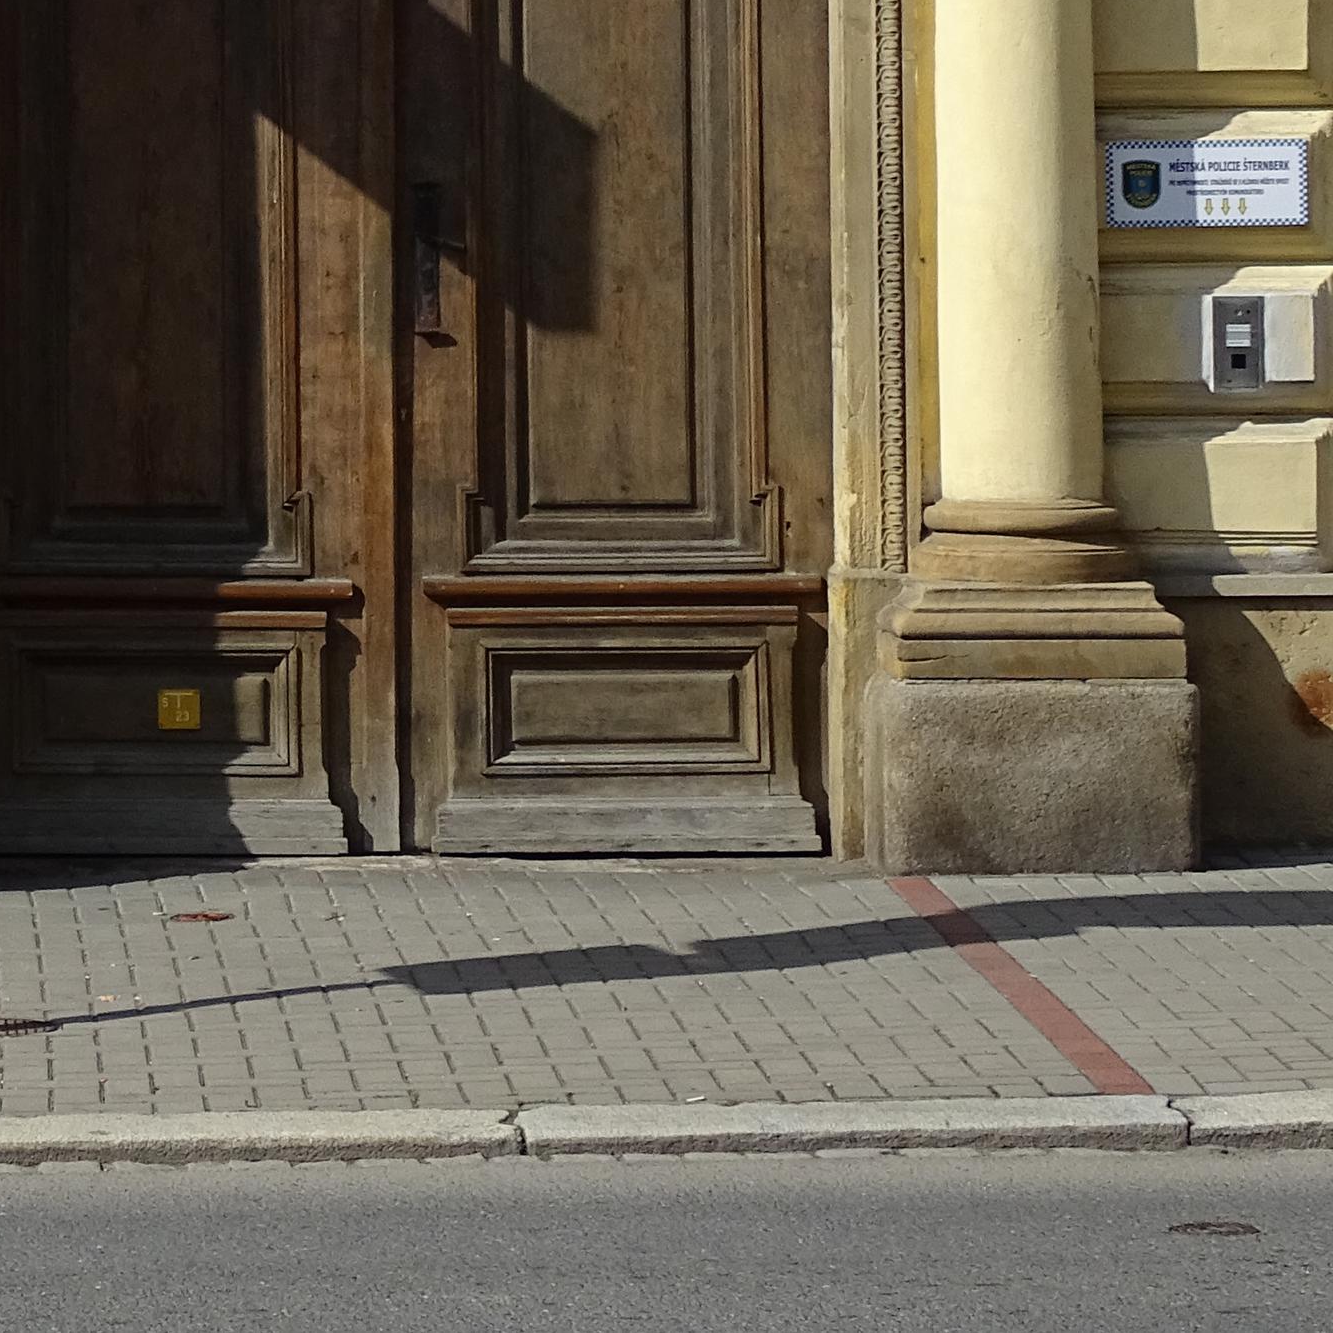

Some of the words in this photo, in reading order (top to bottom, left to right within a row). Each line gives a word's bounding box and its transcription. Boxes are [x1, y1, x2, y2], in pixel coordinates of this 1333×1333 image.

[1169, 158, 1205, 172] MĚSTSKÁ
[1207, 160, 1241, 172] POLICIE
[1242, 157, 1290, 171] ŠTERNBERK
[175, 711, 190, 722] 23
